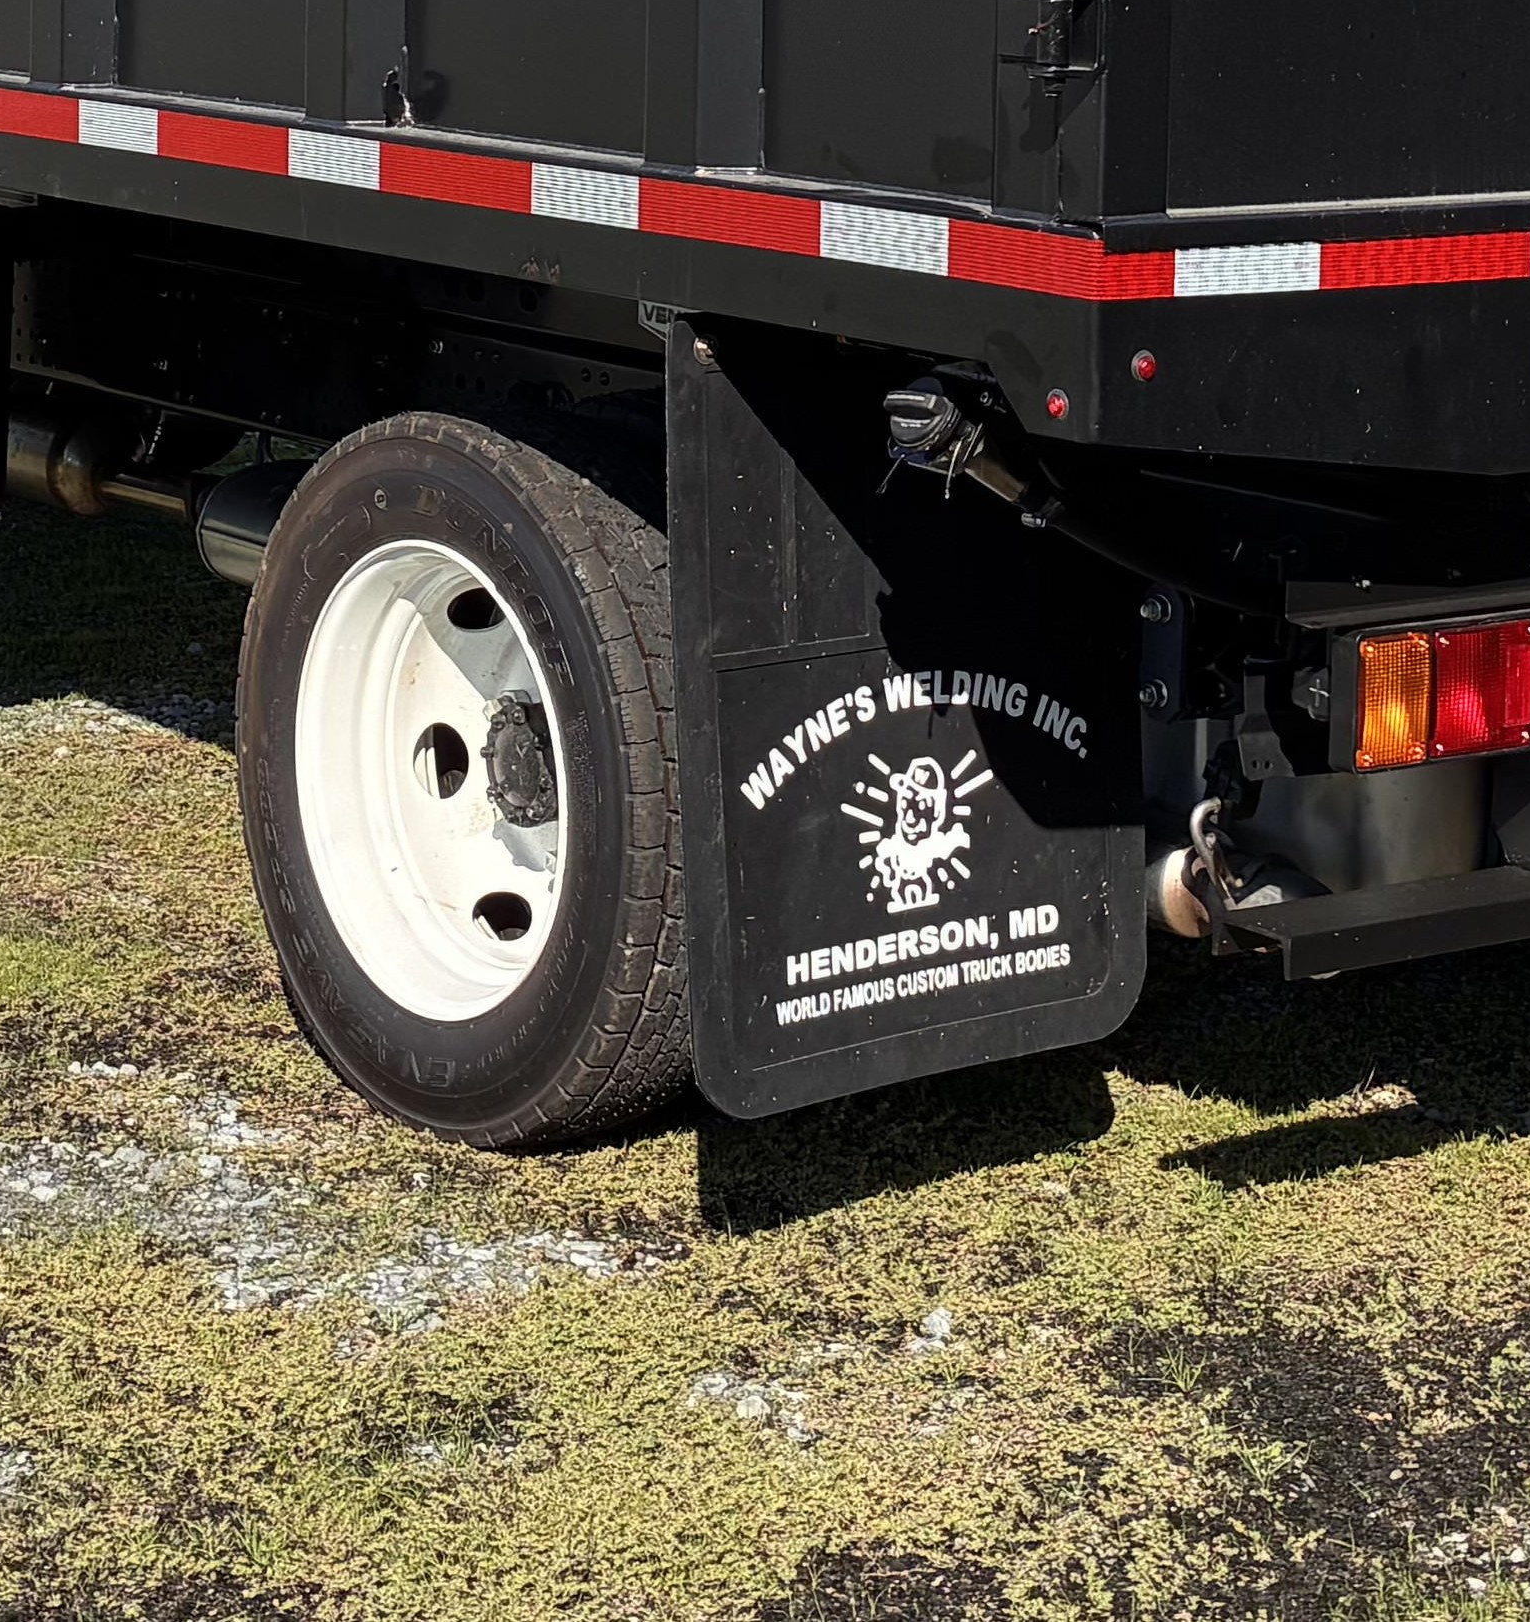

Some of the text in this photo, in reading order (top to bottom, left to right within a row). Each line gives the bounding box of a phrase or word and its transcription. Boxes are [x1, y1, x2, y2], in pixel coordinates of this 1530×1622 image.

[740, 670, 1088, 810] WAYNE'S WELDING INC.
[776, 943, 1071, 1026] WORLD FAMOUS CUSTOM TRUCK BODIES
[786, 904, 1059, 986] HENDERSON, MD
